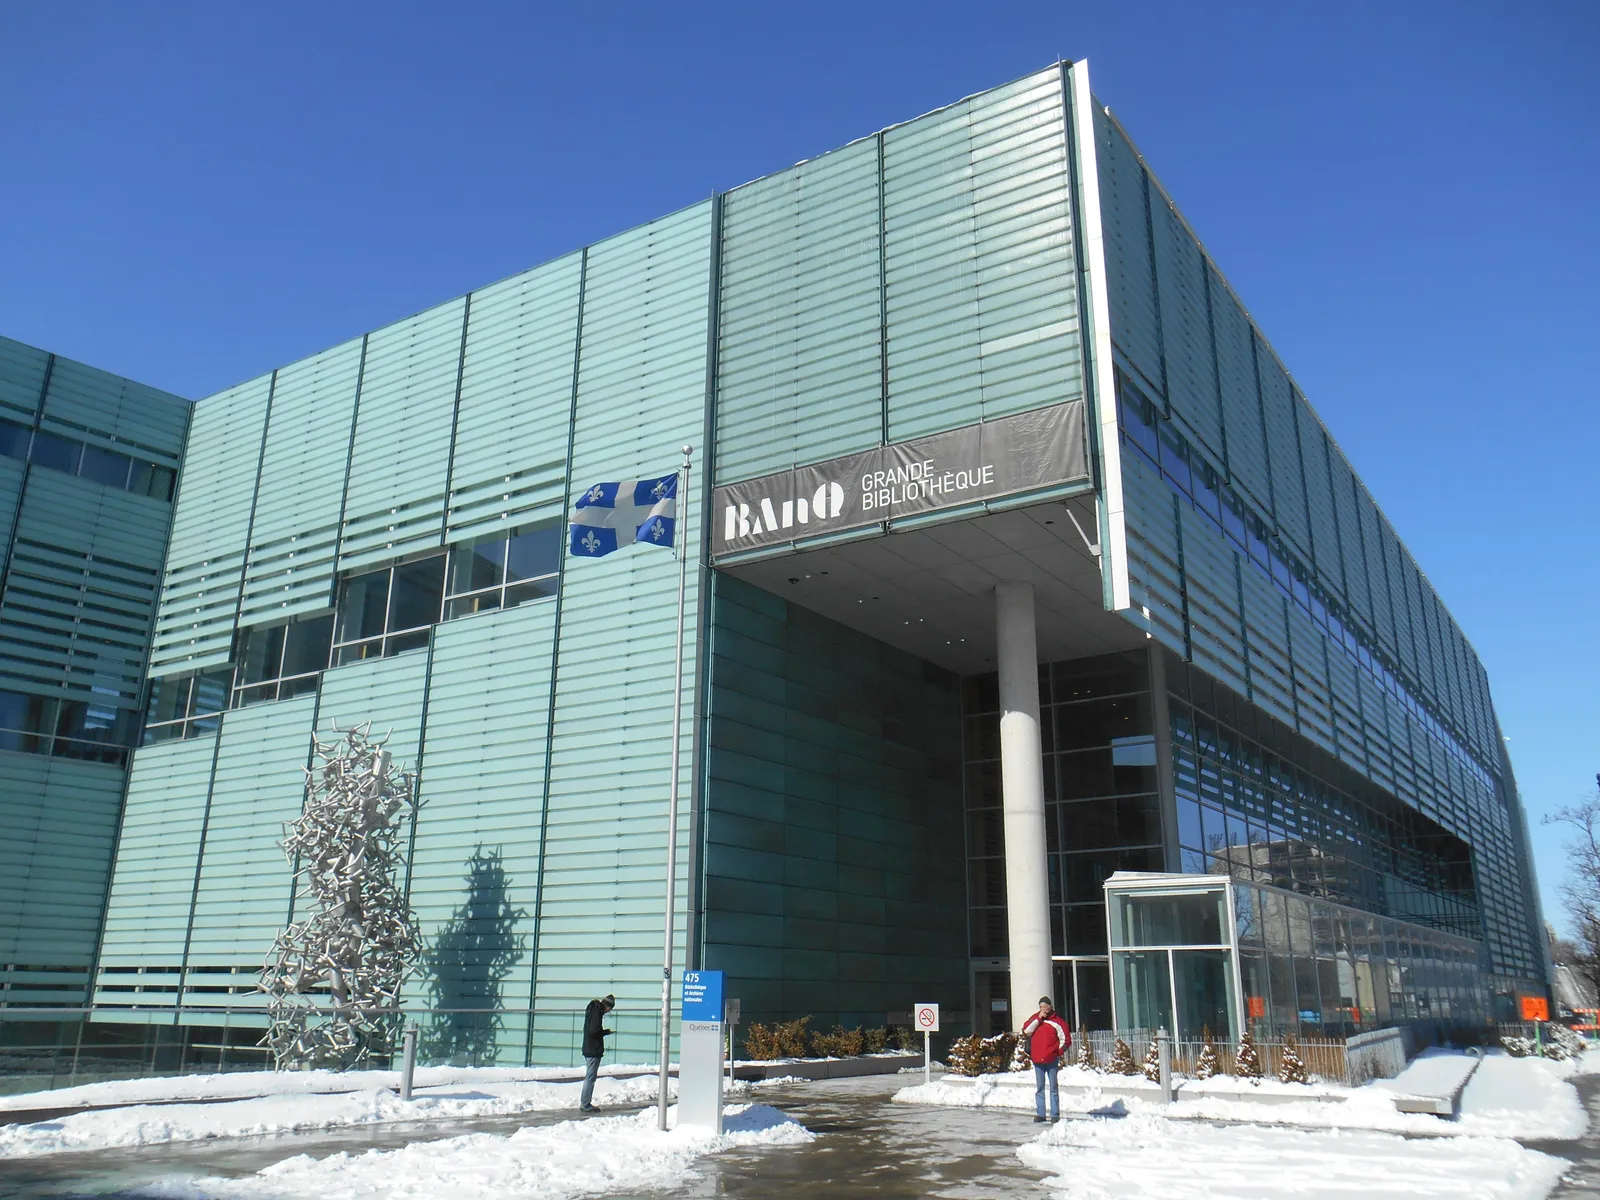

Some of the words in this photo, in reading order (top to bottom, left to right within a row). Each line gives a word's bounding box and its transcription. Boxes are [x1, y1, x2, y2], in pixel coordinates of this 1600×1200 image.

[861, 459, 934, 491] GRANDE
[862, 464, 994, 511] BIBLIOTHÈQUE
[685, 973, 699, 983] 475
[689, 1023, 711, 1031] Québec
